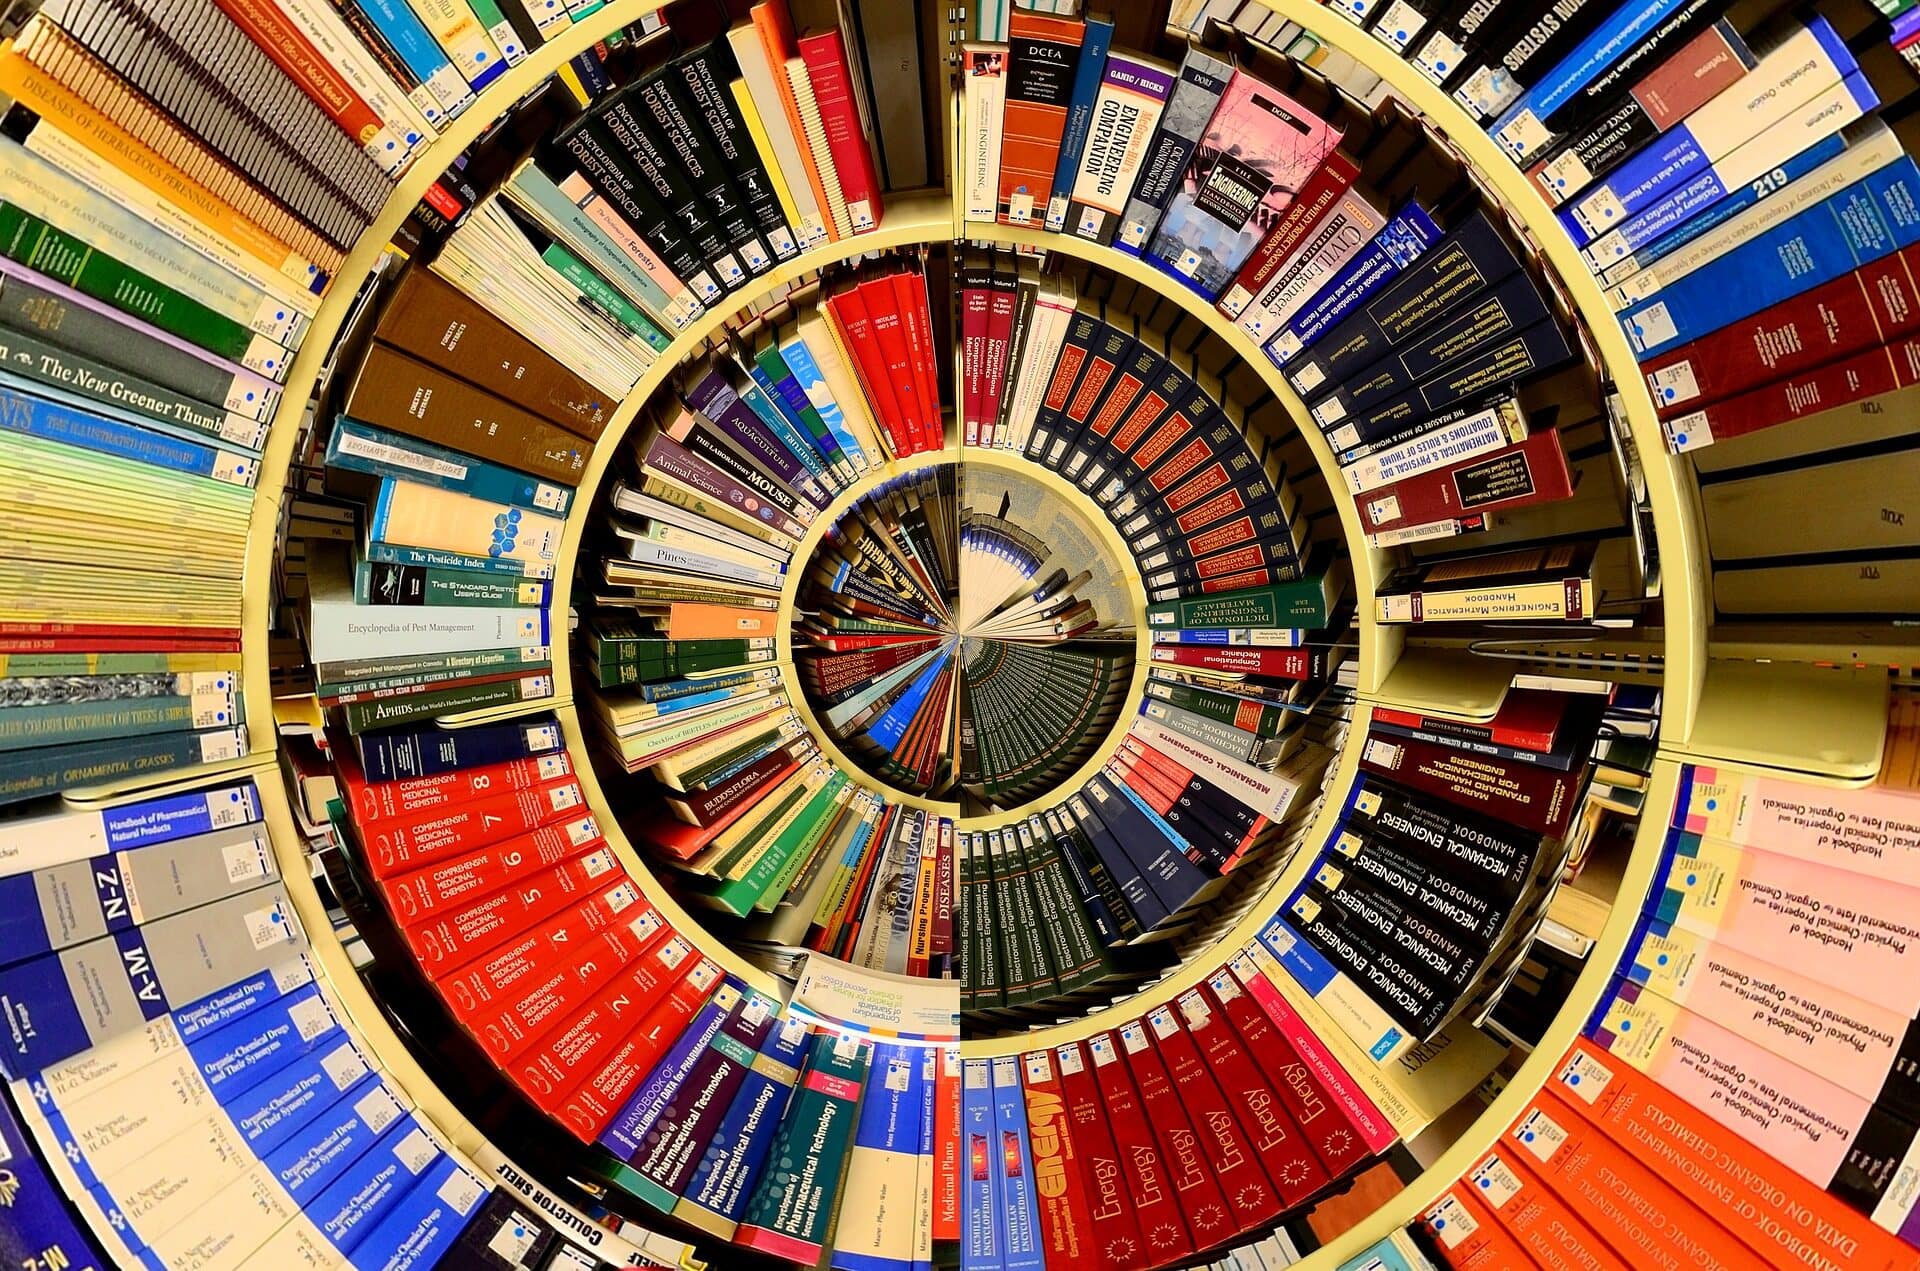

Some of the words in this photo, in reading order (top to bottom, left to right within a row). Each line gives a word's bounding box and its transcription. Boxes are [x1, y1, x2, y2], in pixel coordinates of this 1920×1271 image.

[1029, 45, 1064, 60] DCEA
[1502, 13, 1561, 71] SYSTEMS
[1111, 70, 1134, 83] GANIC
[1134, 78, 1139, 86] /
[1139, 78, 1165, 94] HICKS
[1194, 73, 1213, 87] DORF
[1271, 106, 1294, 121] DORF
[21, 75, 77, 118] DISEASES
[78, 112, 94, 134] OF
[93, 122, 161, 179] HERBACEOUS
[161, 170, 223, 218] PERENNIALS
[615, 102, 656, 156] ENCYCLOPEDIA
[653, 152, 666, 168] OF
[1085, 99, 1120, 177] COMPANION
[578, 129, 624, 183] ENCYCLOPEDIA
[618, 178, 634, 191] OF
[603, 110, 636, 156] FOREST
[632, 151, 673, 199] SCIENCES
[1097, 104, 1139, 197] ENGINEERING
[566, 139, 603, 181] FOREST
[599, 174, 643, 221] SCIENCES
[1235, 166, 1252, 179] THE
[1751, 168, 1789, 199] 219
[1291, 204, 1306, 220] DESK
[1261, 216, 1297, 255] REFERENCE
[1301, 214, 1346, 262] ILLUSTRATED
[1262, 258, 1307, 307] SOURCEBOOK
[440, 321, 458, 346] FORESTRY
[447, 323, 467, 352] ABSTRACTS
[972, 337, 981, 394] Computational
[41, 356, 72, 383] The
[72, 368, 108, 393] New
[110, 382, 172, 415] Greener
[174, 404, 222, 433] Thumb
[1440, 433, 1451, 442] &
[1452, 416, 1494, 438] EQUATIONS
[730, 415, 791, 471] AQUACULTURE
[1379, 448, 1405, 465] THUMB
[1406, 444, 1417, 455] OF
[1417, 436, 1440, 452] RULES
[654, 454, 691, 479] Animal
[690, 471, 723, 497] Science
[695, 435, 711, 449] THE
[708, 442, 750, 479] LABORATORY
[747, 472, 794, 508] MOUSE
[410, 552, 424, 562] The
[426, 554, 461, 567] Pesticide
[463, 557, 485, 569] Index
[656, 548, 687, 566] Pines
[432, 581, 447, 589] THE
[449, 582, 487, 592] STANDARD
[1465, 592, 1516, 603] HANDBOOK
[1193, 607, 1264, 617] ENGINEERING
[1197, 599, 1255, 609] MATERIALS
[1205, 613, 1269, 623] DICTIONARY
[1427, 606, 1490, 616] MATHEMATICS
[1492, 601, 1560, 614] ENGINEERING
[348, 623, 400, 634] Encyclopedia
[402, 623, 410, 632] of
[412, 624, 426, 633] Pest
[428, 624, 474, 635] Management
[1203, 655, 1261, 666] Computational
[1220, 650, 1261, 659] Mechanics
[1170, 719, 1207, 739] DESIGN
[1201, 722, 1249, 746] DATABOOK
[1158, 733, 1215, 768] COMPONENTS
[1205, 732, 1247, 757] MACHINE
[47, 773, 57, 786] of
[63, 759, 129, 782] ORNAMENTAL
[134, 753, 175, 769] GRASSES
[1215, 763, 1271, 795] MECHANICAL
[1418, 764, 1473, 786] HANDBOOK
[1433, 760, 1496, 783] MECHANICAL
[1450, 756, 1506, 776] ENGINEERS
[400, 773, 457, 791] COMPREHENSIVE
[402, 787, 440, 800] MEDICINAL
[473, 775, 490, 789] 8
[704, 789, 735, 812] BUDD'S
[732, 771, 760, 794] FLORA
[1451, 785, 1489, 801] MARKS'
[1474, 782, 1531, 804] STANDARD
[1498, 779, 1520, 790] FOR
[109, 814, 147, 830] Handbook
[148, 812, 156, 822] of
[156, 803, 207, 822] Pharmaceutical
[404, 796, 442, 810] CHEMISTRY
[111, 827, 141, 843] Natural
[143, 823, 172, 839] Products
[484, 815, 503, 828] 7
[1376, 810, 1444, 851] ENGINEERS'
[1452, 823, 1516, 858] HANDBOOK
[504, 851, 522, 866] 6
[1445, 838, 1510, 877] MECHANICAL
[1512, 853, 1529, 882] KUTZ
[95, 868, 128, 920] N-Z
[525, 888, 542, 904] 5
[920, 870, 931, 914] Programs
[939, 855, 951, 920] DISEASES
[1020, 877, 1035, 927] Engineering
[454, 895, 509, 925] COMPREHENSIVE
[458, 913, 497, 935] MEDICINAL
[976, 892, 984, 931] Electrical
[982, 884, 991, 935] Engineering
[1336, 887, 1395, 936] ENGINEERS'
[552, 928, 569, 942] 4
[915, 914, 929, 955] Nursing
[1394, 922, 1451, 976] MECHANICAL
[987, 937, 995, 985] Electronics
[1031, 929, 1047, 976] Electronics
[123, 948, 161, 1002] A-M
[579, 961, 597, 978] 3
[1454, 956, 1474, 984] KUTZ
[612, 994, 631, 1012] 2
[852, 1008, 900, 1023] Compendium
[857, 1002, 891, 1013] Standards
[1752, 1012, 1765, 1021] of
[1766, 1018, 1816, 1045] Handbook
[211, 1071, 226, 1084] and
[226, 1059, 244, 1077] Their
[244, 1040, 281, 1066] Synonyms
[1398, 1032, 1452, 1075] ENERGY
[632, 1094, 665, 1139] SOLUBILITY
[660, 1081, 677, 1100] DATA
[673, 1070, 684, 1085] for
[681, 1012, 727, 1075] PHARMACEUTICALS
[622, 1078, 667, 1132] HANDBOOK
[662, 1065, 674, 1079] OF
[1711, 1090, 1722, 1100] of
[652, 1108, 701, 1181] Pharmaceutical
[694, 1061, 731, 1110] Technology
[1724, 1097, 1770, 1130] Handbook
[1642, 1104, 1718, 1158] CHEMICALS
[641, 1130, 672, 1173] Encyclopedia
[669, 1122, 678, 1132] of
[947, 1142, 955, 1173] Plants
[1628, 1119, 1736, 1203] ENVIRONMENTAL
[495, 1162, 532, 1196] SHELF
[665, 1163, 685, 1188] Second
[680, 1140, 697, 1164] Edition
[786, 1153, 819, 1235] Pharmaceutical
[810, 1101, 837, 1161] Technology
[1130, 1144, 1163, 1209] Energy
[1094, 1156, 1121, 1221] Energy
[1716, 1153, 1787, 1208] ORGANIC
[943, 1174, 955, 1222] Medicinal
[1733, 1201, 1754, 1220] OF
[531, 1189, 604, 1248] COLLECTOR
[1784, 1203, 1813, 1227] ON
[972, 1209, 981, 1256] MACMILLAN
[1814, 1218, 1858, 1258] DATA
